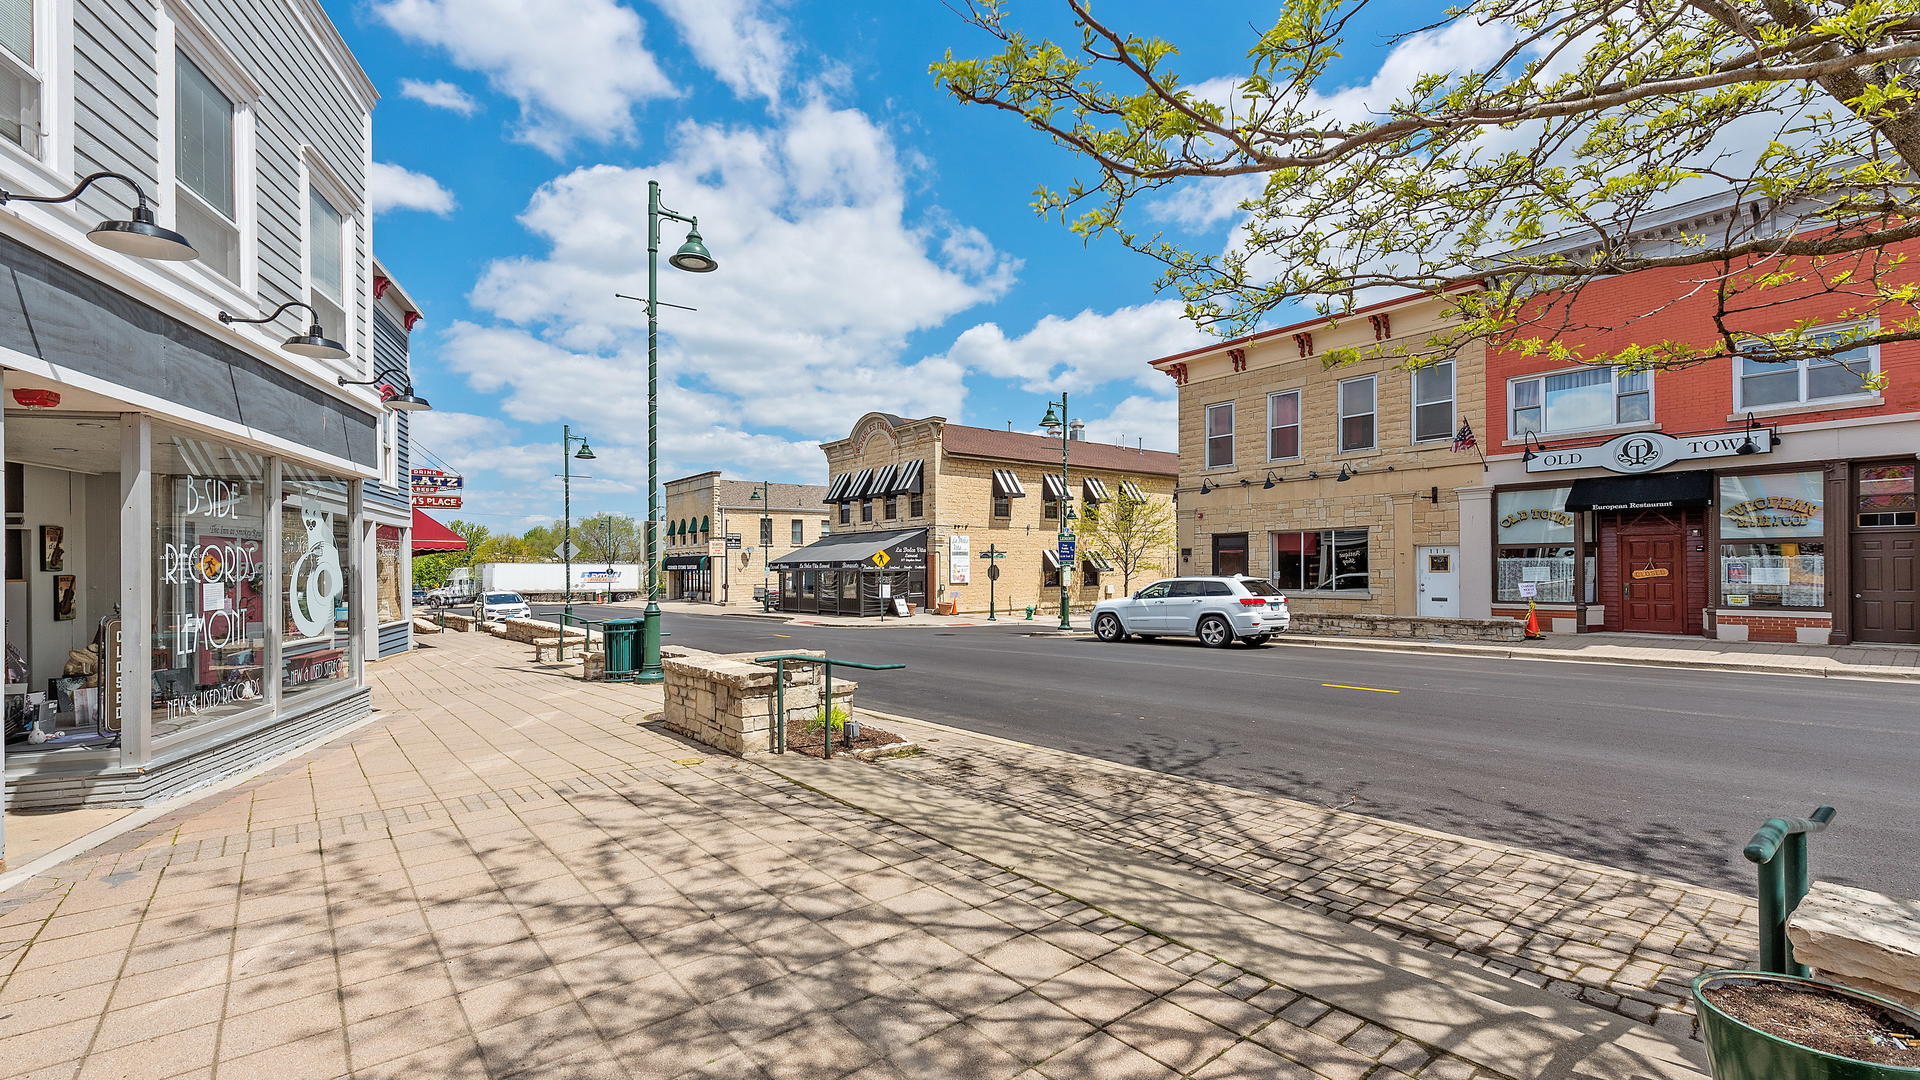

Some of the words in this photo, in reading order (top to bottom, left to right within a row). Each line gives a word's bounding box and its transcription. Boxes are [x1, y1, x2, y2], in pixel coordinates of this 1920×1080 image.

[1544, 453, 1582, 467] OLD
[186, 474, 239, 520] B-SIDE
[426, 498, 457, 506] PLACE
[1629, 501, 1673, 509] Restaurant
[1500, 510, 1529, 529] OLD
[165, 543, 255, 585] RECORDS
[176, 608, 247, 656] LEMONT
[290, 668, 303, 686] NEW
[167, 695, 188, 720] NEW
[200, 688, 221, 710] USED
